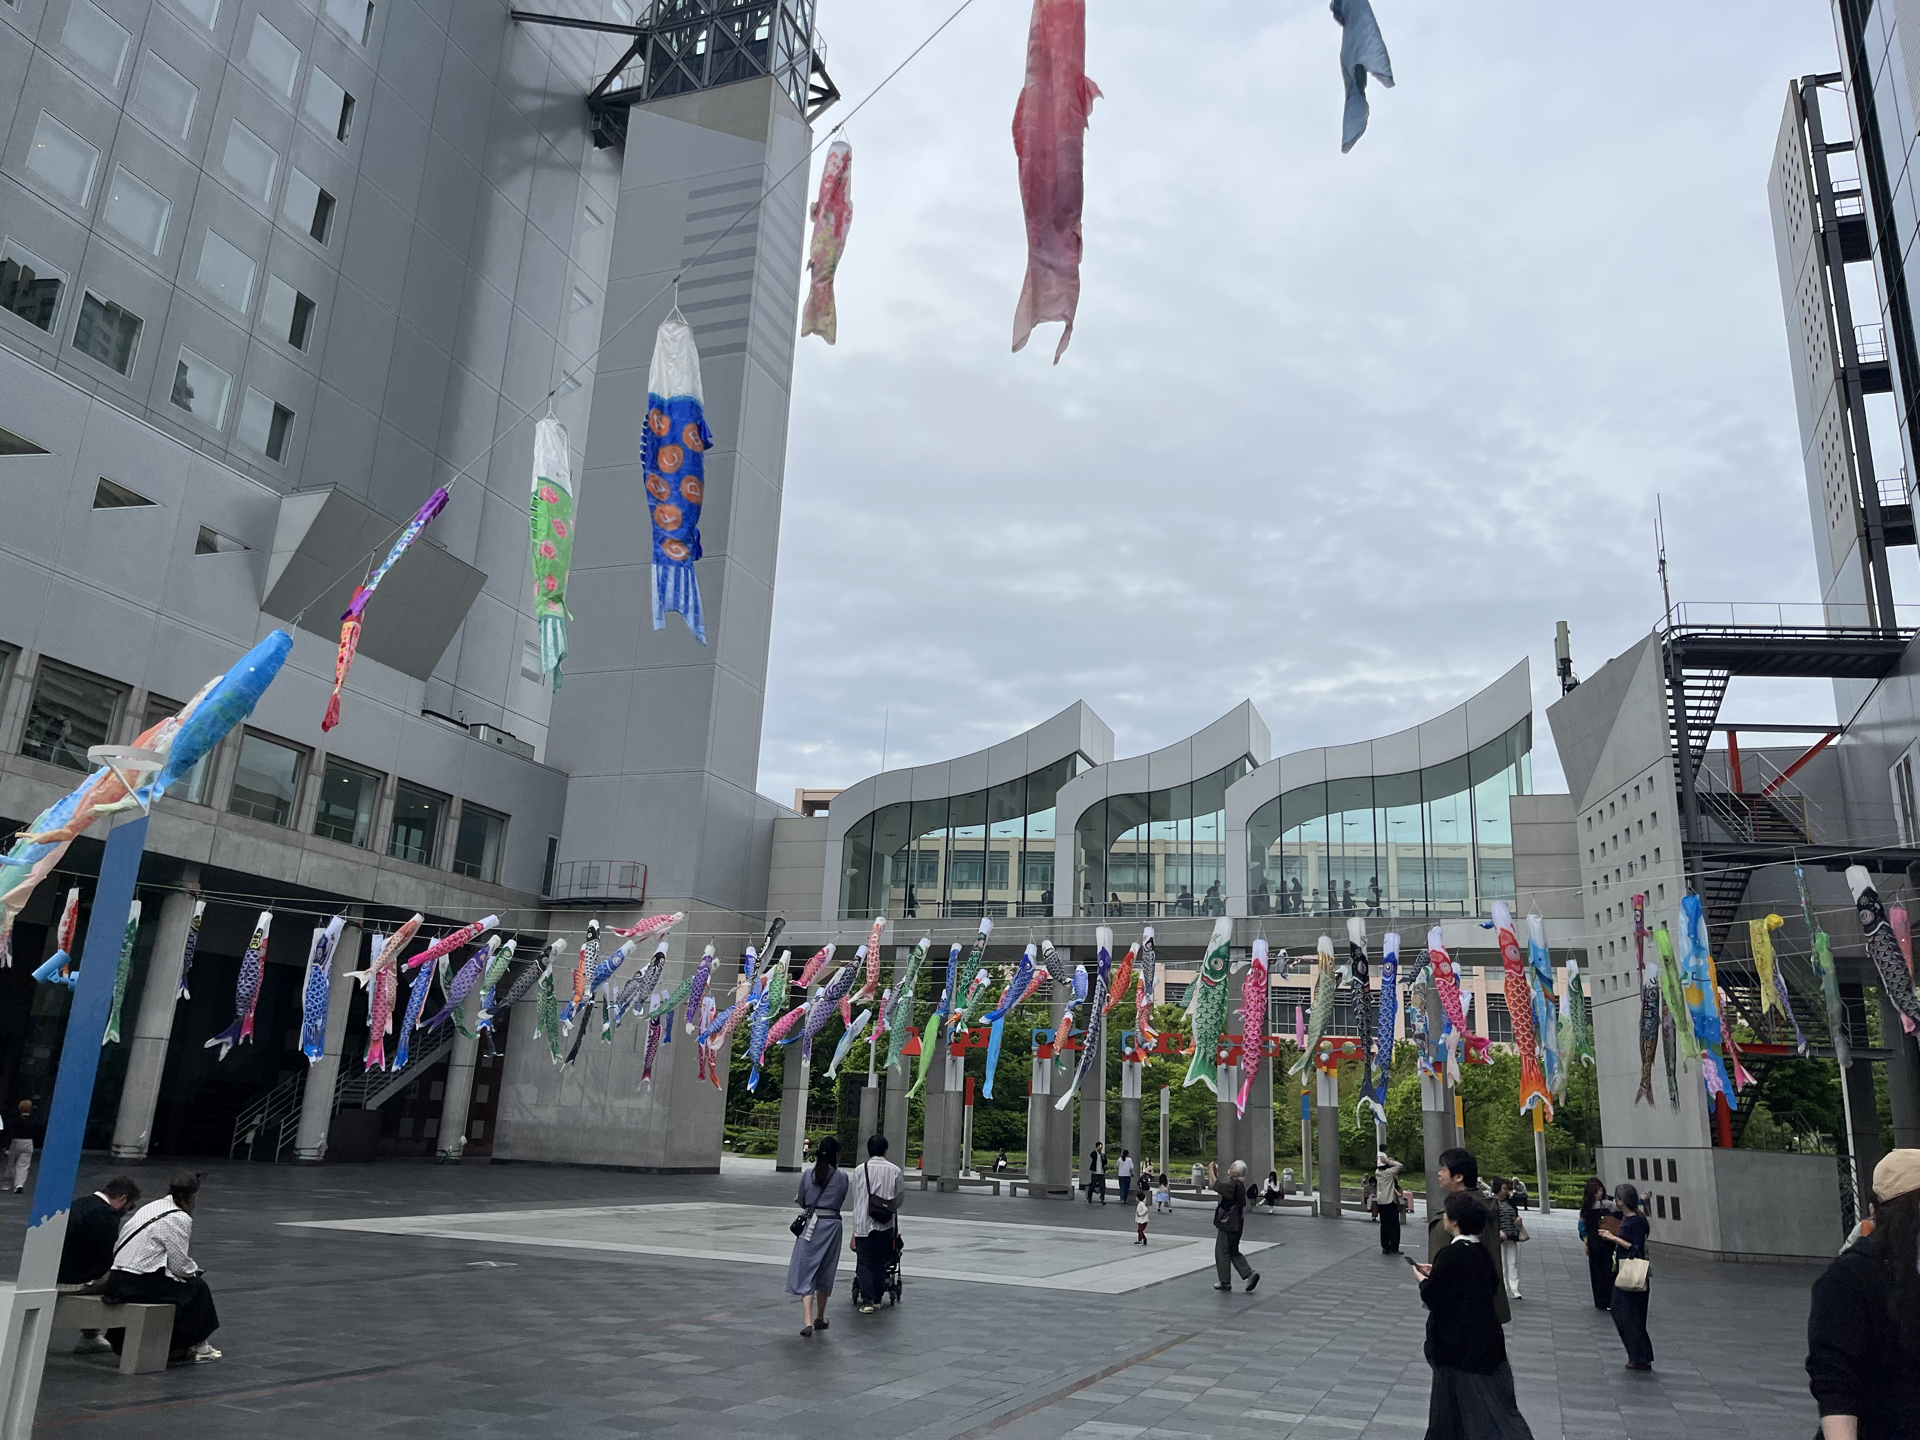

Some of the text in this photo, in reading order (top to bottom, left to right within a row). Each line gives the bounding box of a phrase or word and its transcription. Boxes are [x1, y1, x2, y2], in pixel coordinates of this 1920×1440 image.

[652, 413, 666, 432] A
[687, 430, 702, 446] B
[662, 452, 679, 467] C
[686, 482, 702, 497] D
[659, 513, 678, 524] F
[665, 545, 686, 558] G
